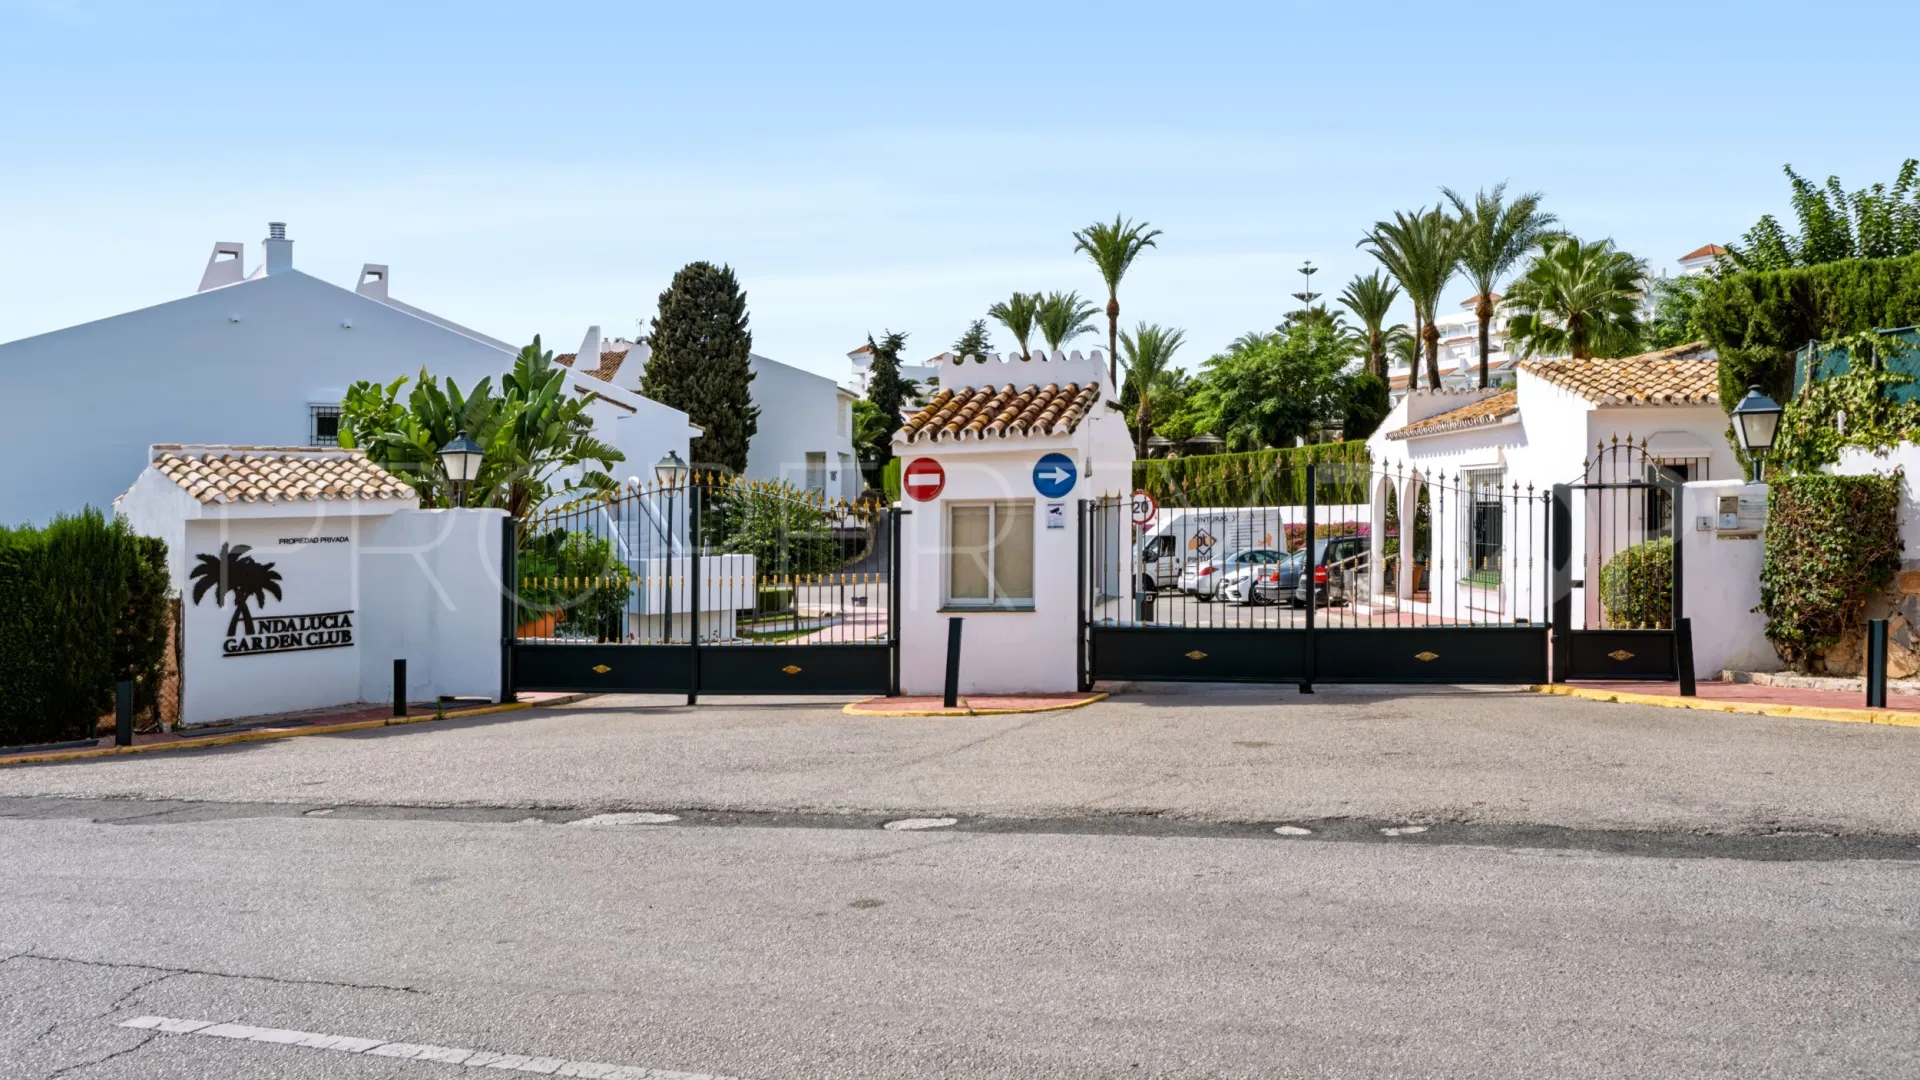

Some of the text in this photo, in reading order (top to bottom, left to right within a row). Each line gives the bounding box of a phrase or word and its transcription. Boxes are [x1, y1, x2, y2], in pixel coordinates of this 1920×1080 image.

[1132, 501, 1149, 514] 20
[278, 535, 350, 545] PROPIEDAD PRIVADA
[226, 601, 353, 637] ANDALUCIA
[223, 629, 352, 653] GARDEN CLUB
